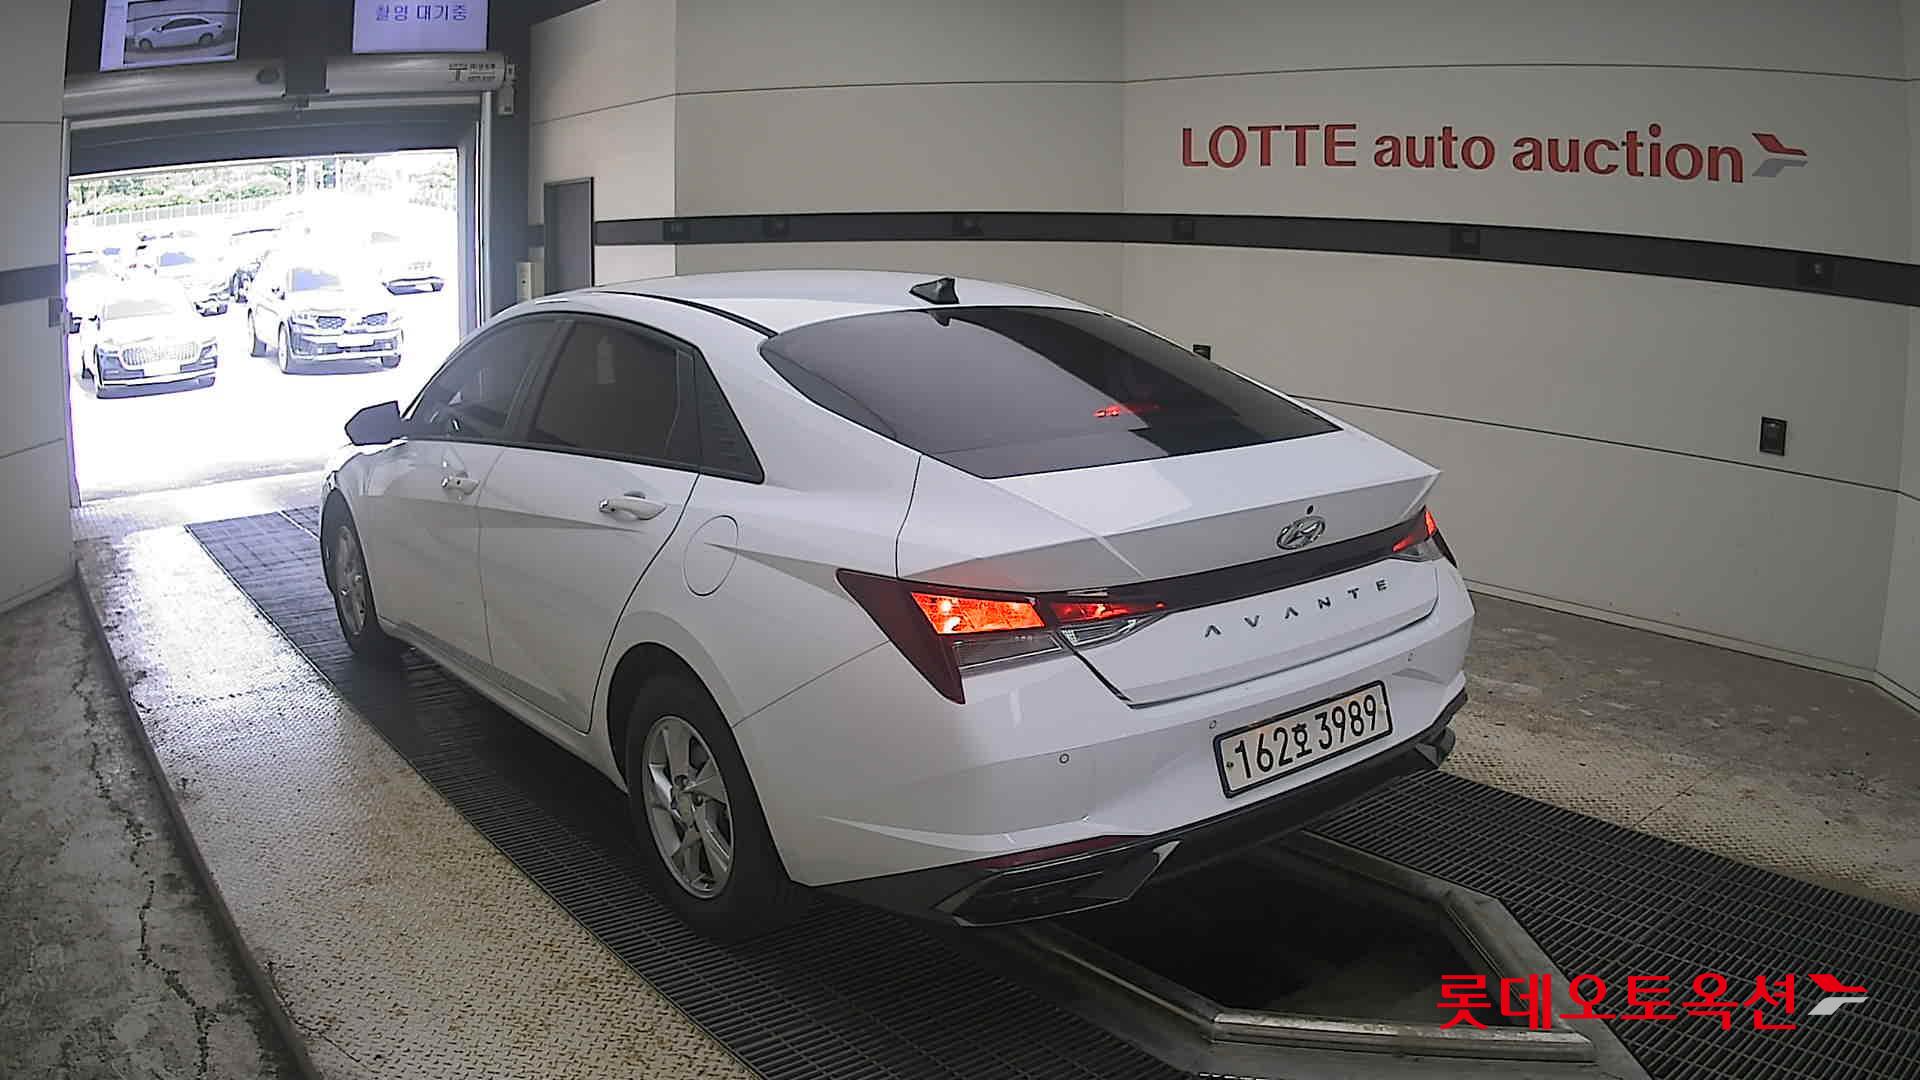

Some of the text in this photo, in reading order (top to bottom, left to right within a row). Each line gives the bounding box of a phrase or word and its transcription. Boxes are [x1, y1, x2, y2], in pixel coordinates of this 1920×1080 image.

[415, 3, 468, 21] 대기중
[1182, 123, 1744, 184] LOTTE auto auction
[1203, 578, 1389, 639] AVANTE
